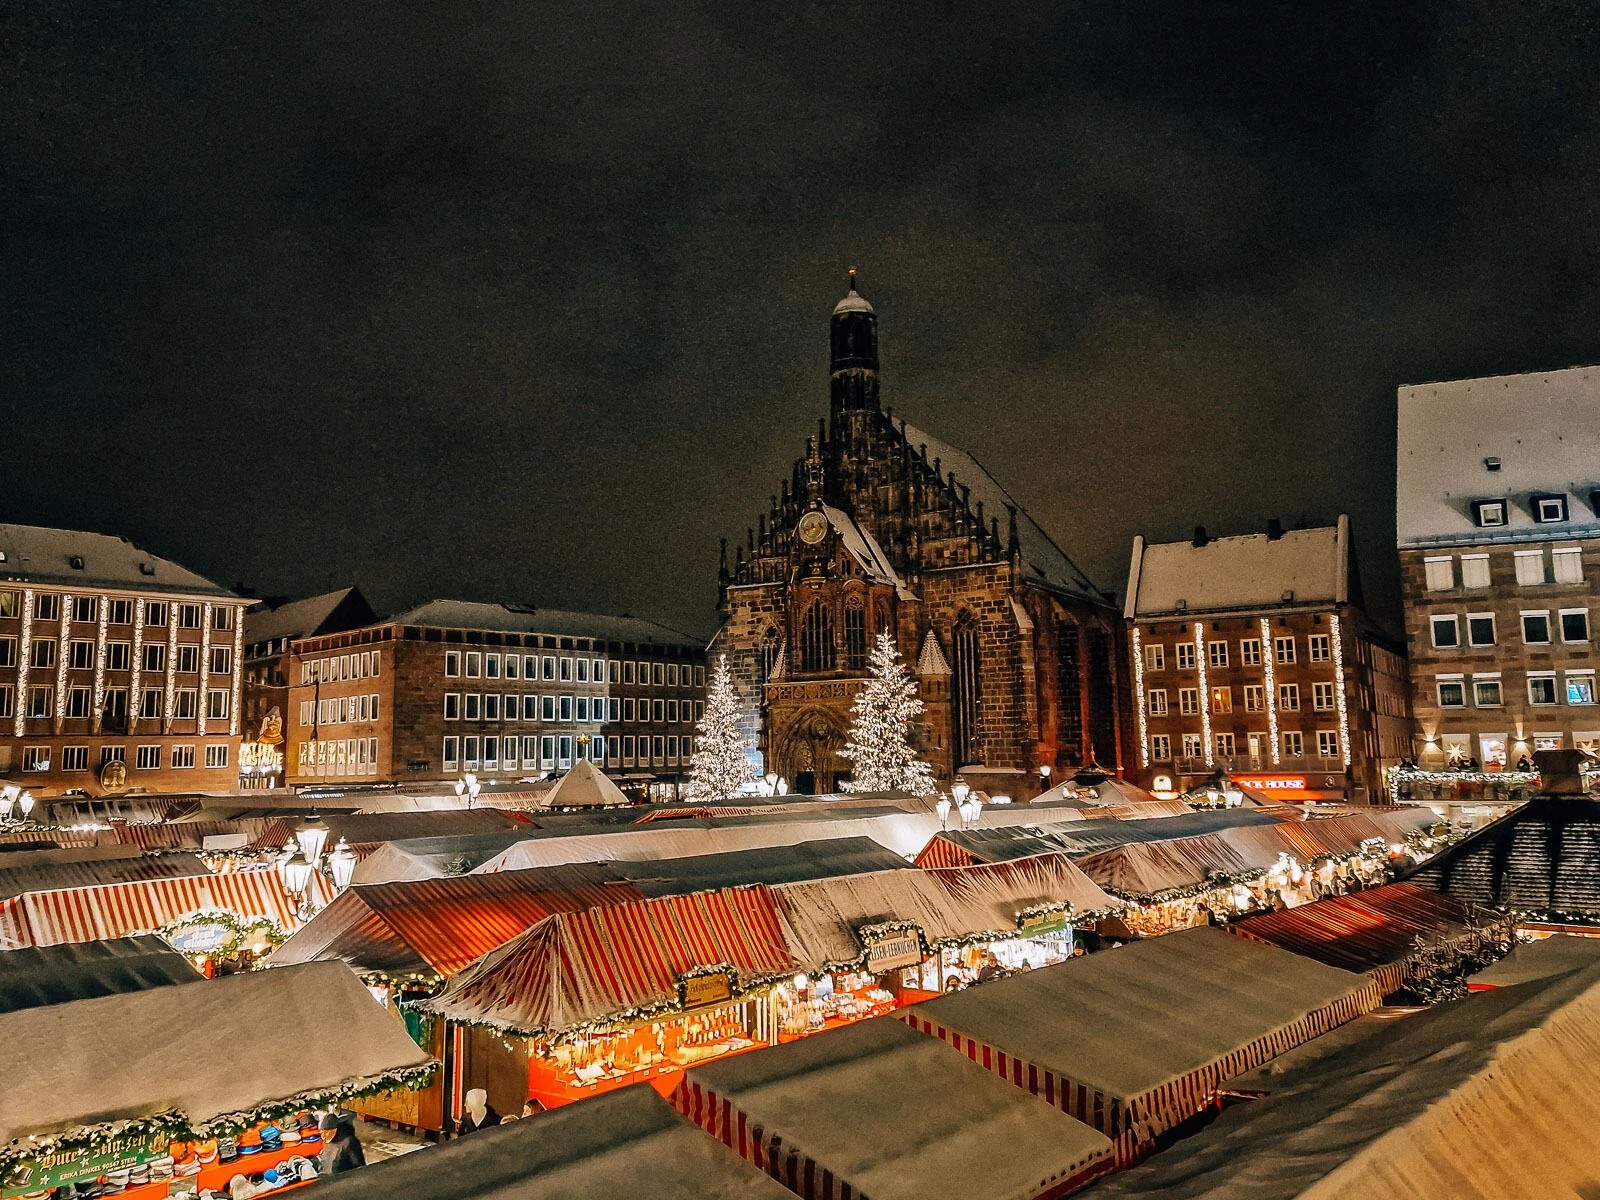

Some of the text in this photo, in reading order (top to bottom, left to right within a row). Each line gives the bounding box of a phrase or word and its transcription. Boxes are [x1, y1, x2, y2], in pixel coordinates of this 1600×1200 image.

[1265, 779, 1305, 789] HOUSE
[59, 1170, 78, 1181] ERIKA
[79, 1166, 102, 1176] DINKEL
[120, 1156, 137, 1166] STEIN
